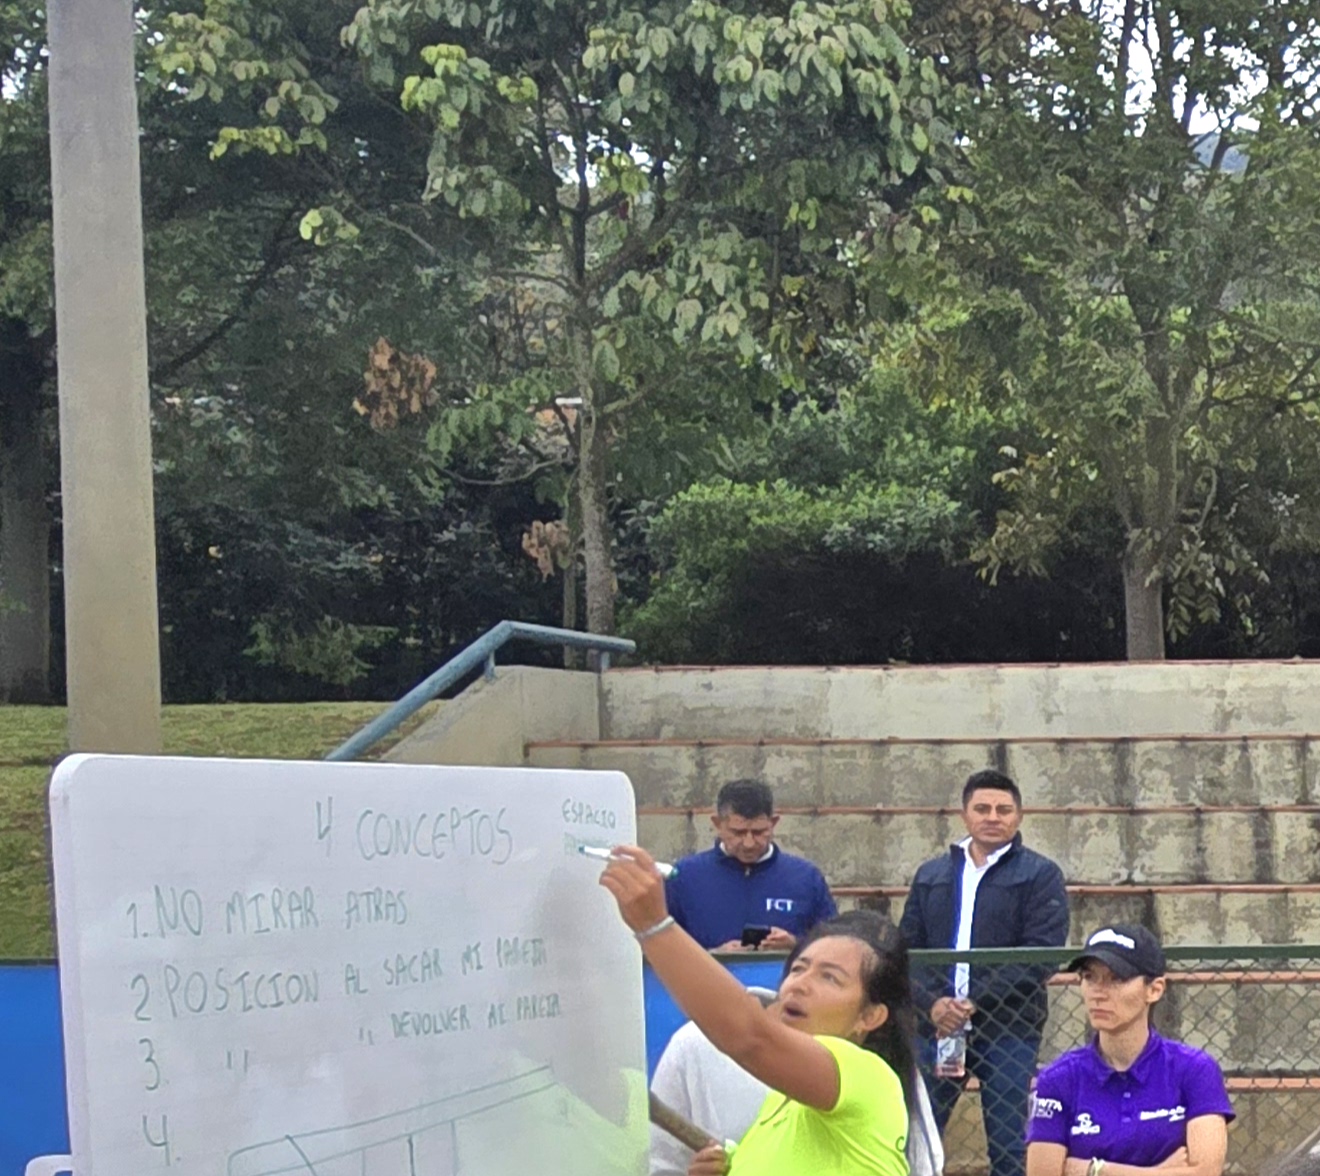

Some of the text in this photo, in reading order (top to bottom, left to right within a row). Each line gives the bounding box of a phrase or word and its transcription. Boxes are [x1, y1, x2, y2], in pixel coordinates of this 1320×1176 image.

[356, 806, 513, 865] CONCEPTOS
[154, 884, 204, 939] NO
[225, 886, 319, 934] MIRAR
[344, 886, 408, 930] ATRAS
[163, 964, 319, 1019] POSICION
[343, 962, 369, 995] AL
[383, 947, 444, 987] SACAR
[460, 941, 484, 976] MI
[390, 1003, 471, 1039] DEVOLVER
